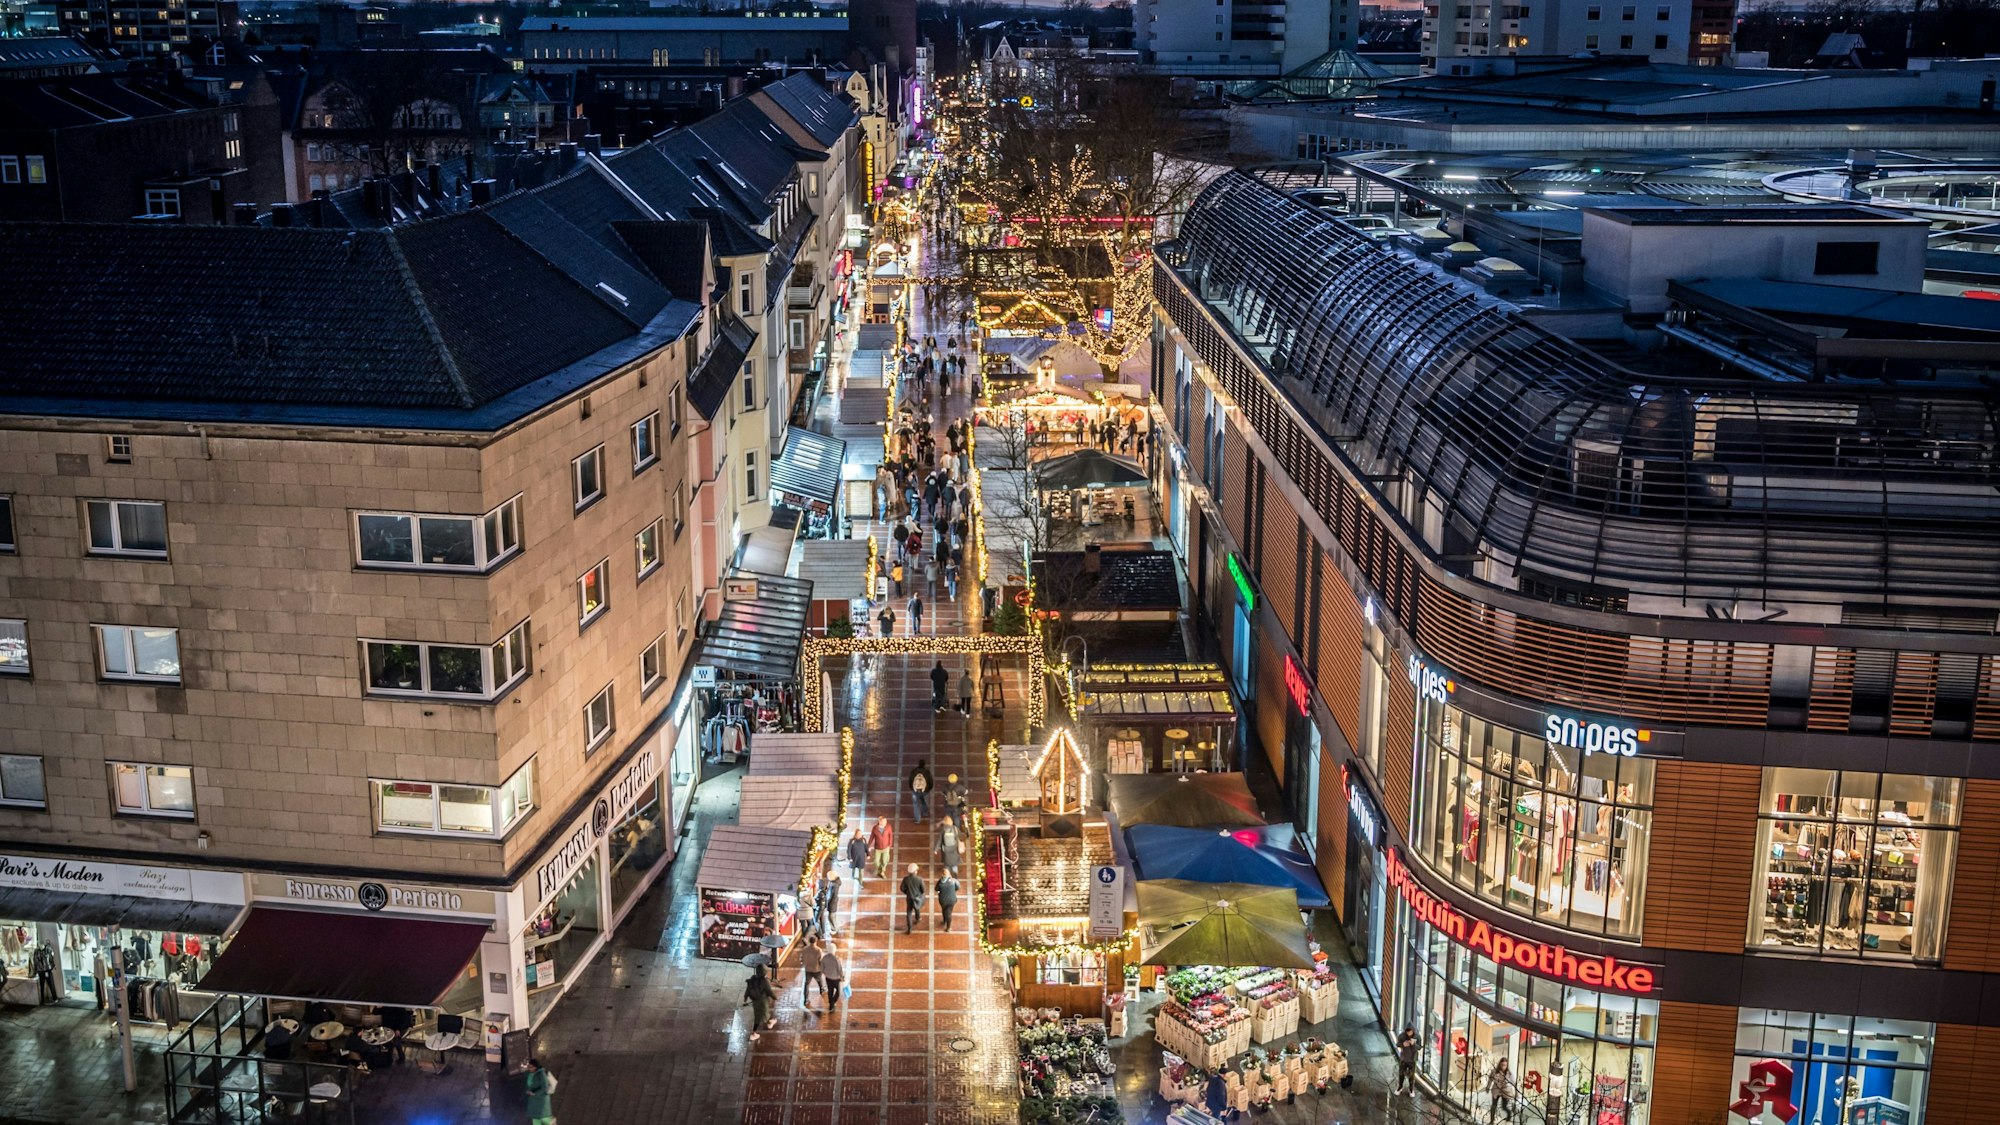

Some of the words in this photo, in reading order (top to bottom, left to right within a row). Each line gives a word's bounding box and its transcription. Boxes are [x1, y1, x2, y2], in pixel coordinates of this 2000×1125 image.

[1284, 654, 1307, 717] REWE
[1409, 655, 1447, 704] snipes
[1546, 715, 1639, 757] snipes
[43, 862, 104, 882] Moden
[537, 822, 592, 902] Espresso
[11, 879, 43, 888] exclusive
[52, 882, 61, 891] up
[159, 884, 186, 893] design
[285, 879, 355, 902] Espresso
[390, 887, 462, 911] Perfetto
[1468, 920, 1654, 992] Apotheke
